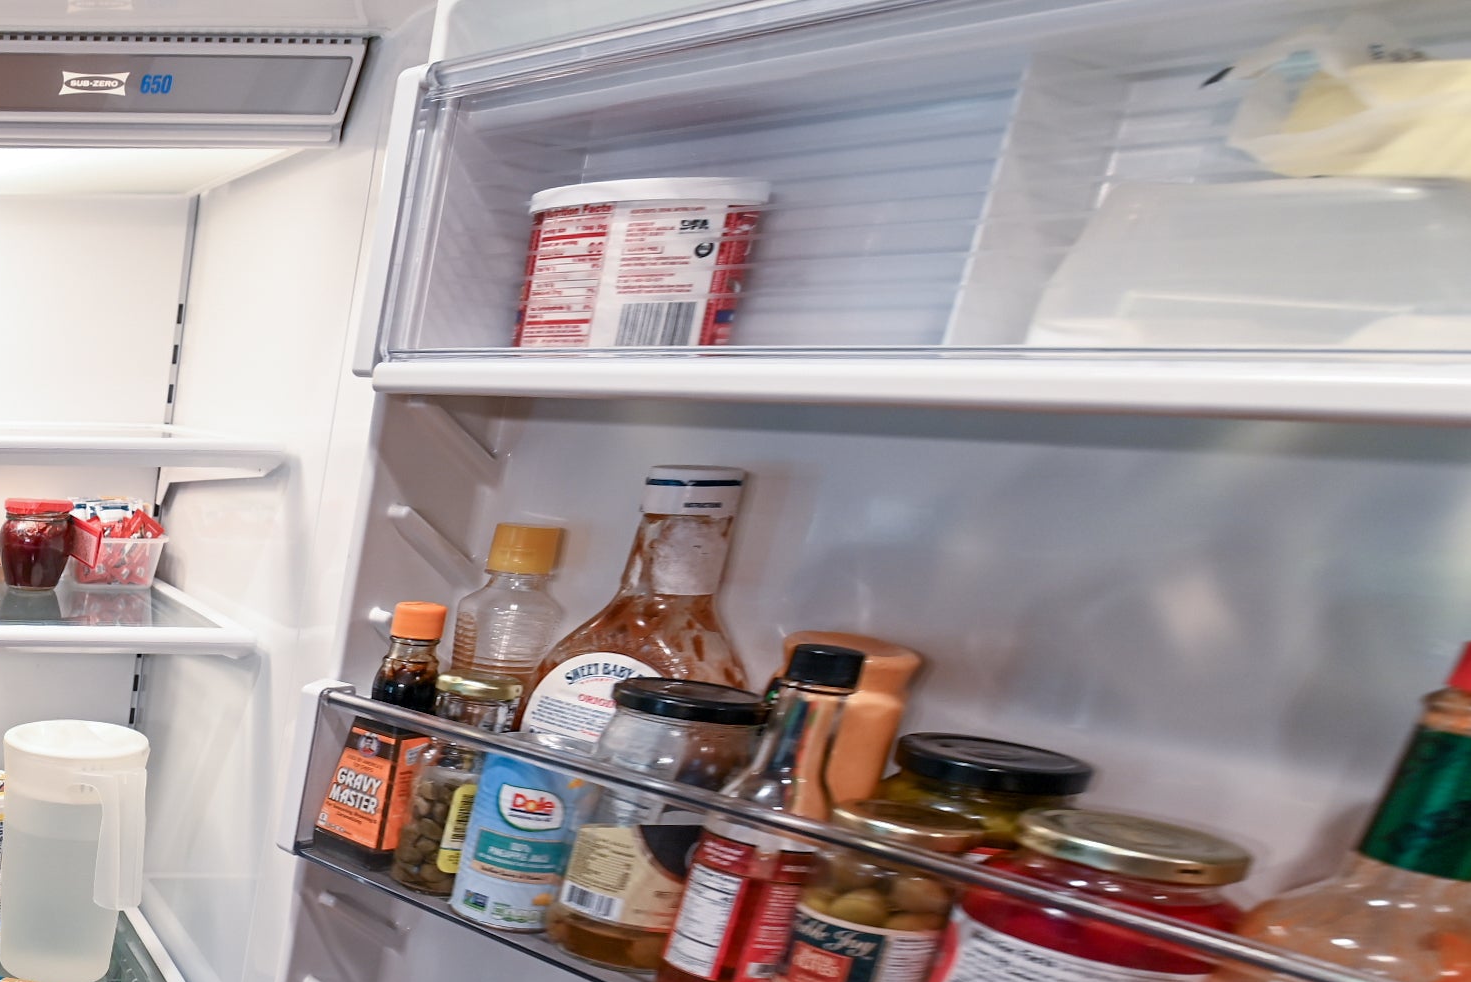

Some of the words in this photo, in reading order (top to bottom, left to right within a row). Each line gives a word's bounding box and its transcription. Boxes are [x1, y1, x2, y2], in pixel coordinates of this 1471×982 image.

[69, 79, 119, 88] SUB-ZERO
[140, 74, 174, 94] 650
[583, 203, 613, 214] Facts
[565, 663, 599, 684] SWEET
[601, 662, 637, 679] BABY
[336, 767, 383, 796] GRAVY
[328, 782, 380, 815] MASTER
[512, 793, 556, 814] Dole
